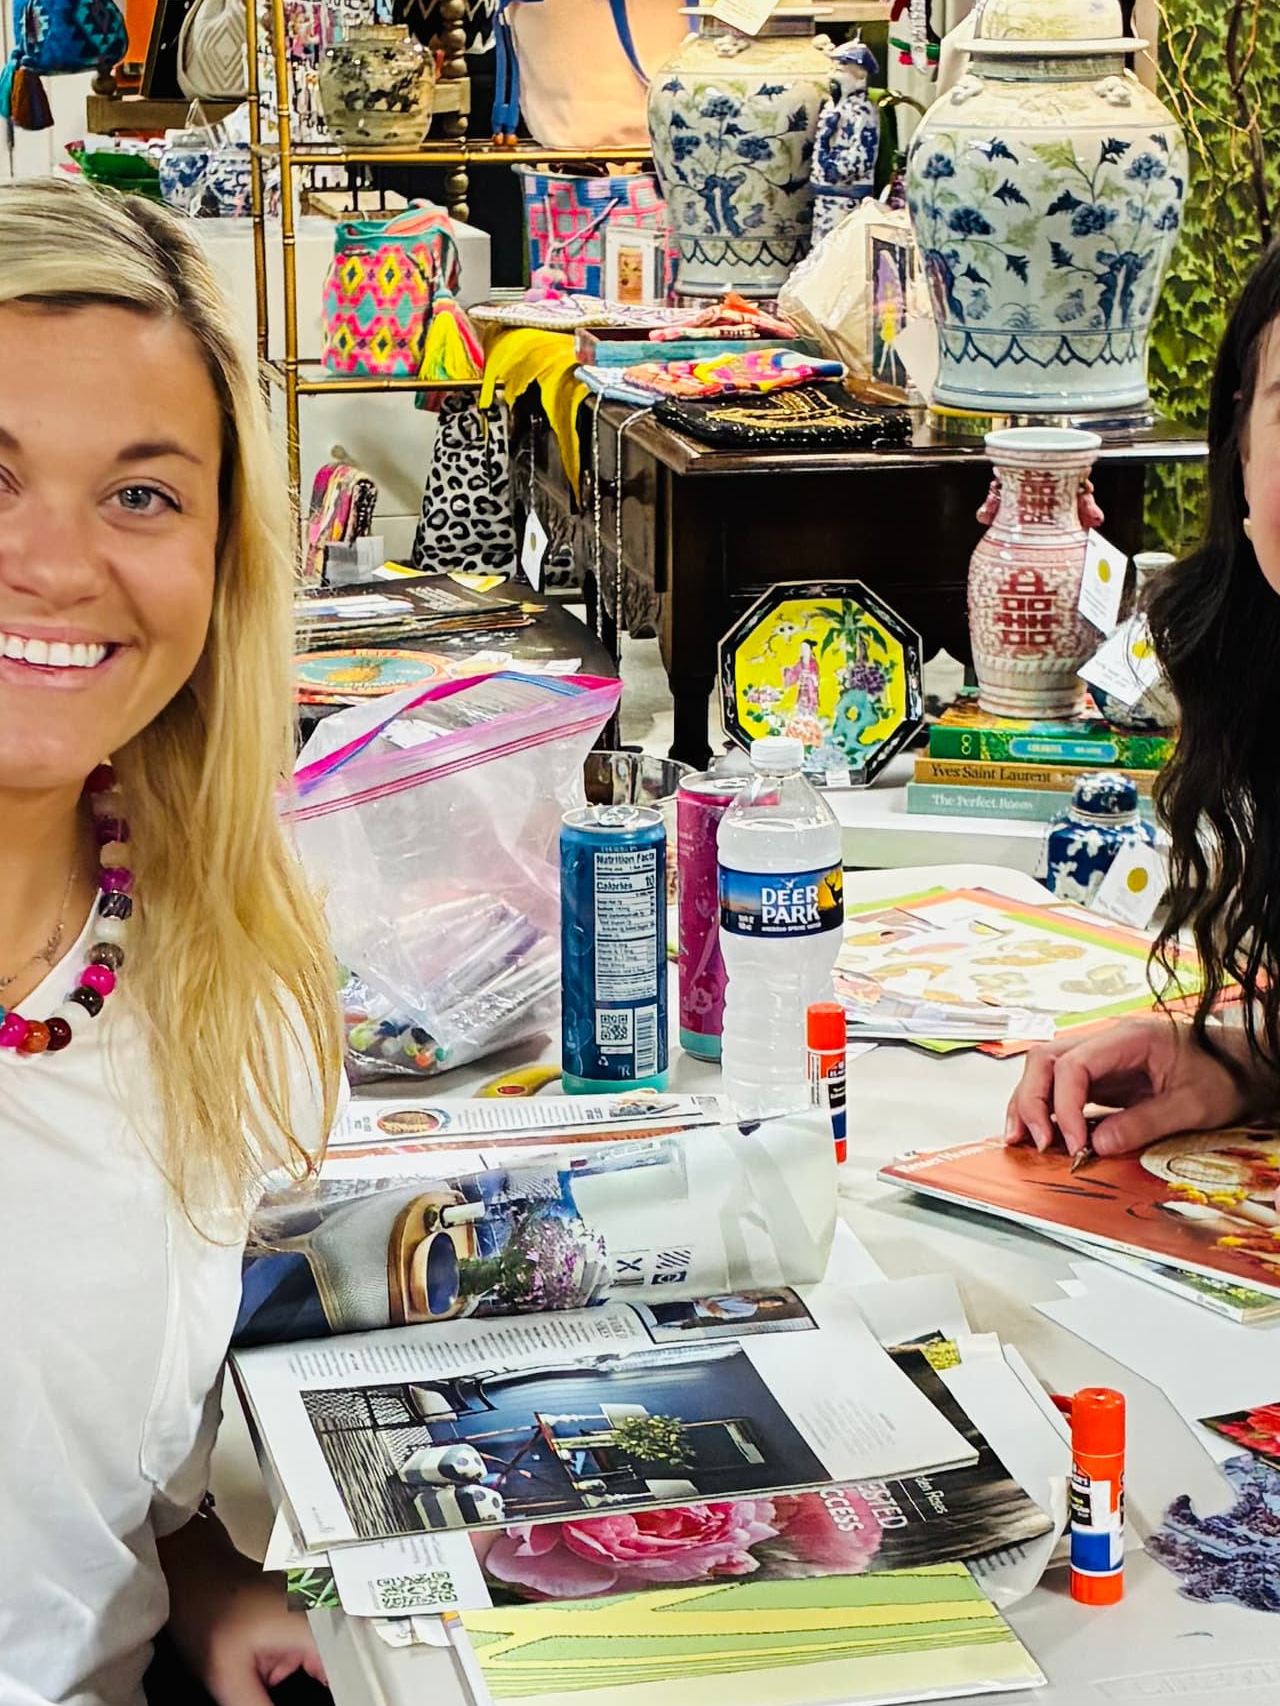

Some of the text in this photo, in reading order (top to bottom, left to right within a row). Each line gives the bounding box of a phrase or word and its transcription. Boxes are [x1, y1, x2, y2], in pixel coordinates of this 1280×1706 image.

[931, 765, 961, 778] Yves
[962, 766, 996, 780] Saint
[999, 768, 1052, 783] Laurent
[932, 793, 1034, 811] The Perfect Room
[596, 854, 634, 865] Nutrition
[596, 881, 633, 890] Calories
[761, 885, 818, 906] DEER
[761, 903, 821, 925] PARK
[820, 1487, 864, 1534] CCESS
[858, 1479, 908, 1530] ESTED
